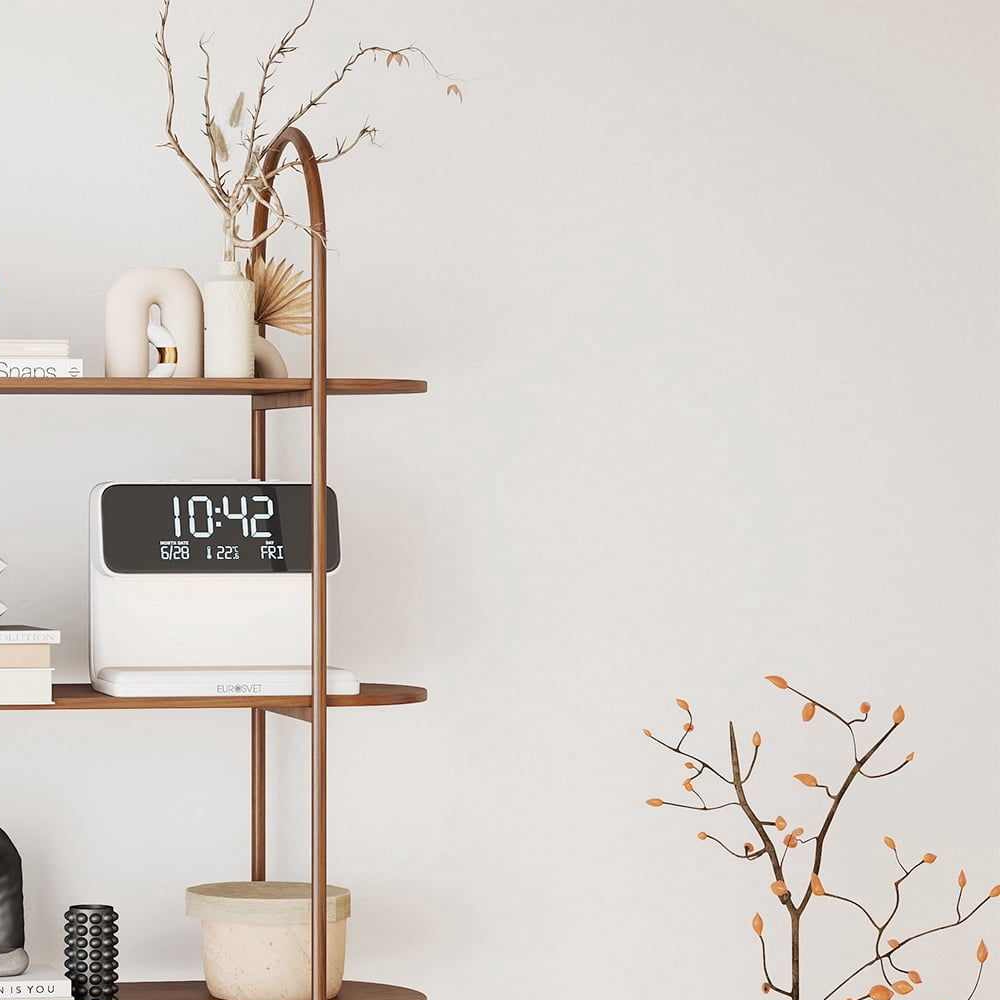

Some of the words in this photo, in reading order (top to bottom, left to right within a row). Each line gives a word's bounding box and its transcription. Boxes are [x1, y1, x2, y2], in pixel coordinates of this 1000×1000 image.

[172, 495, 275, 538] 10:42
[160, 545, 190, 560] 6/28
[260, 545, 284, 560] FRI
[10, 985, 22, 994] IS
[27, 984, 56, 994] YOU
